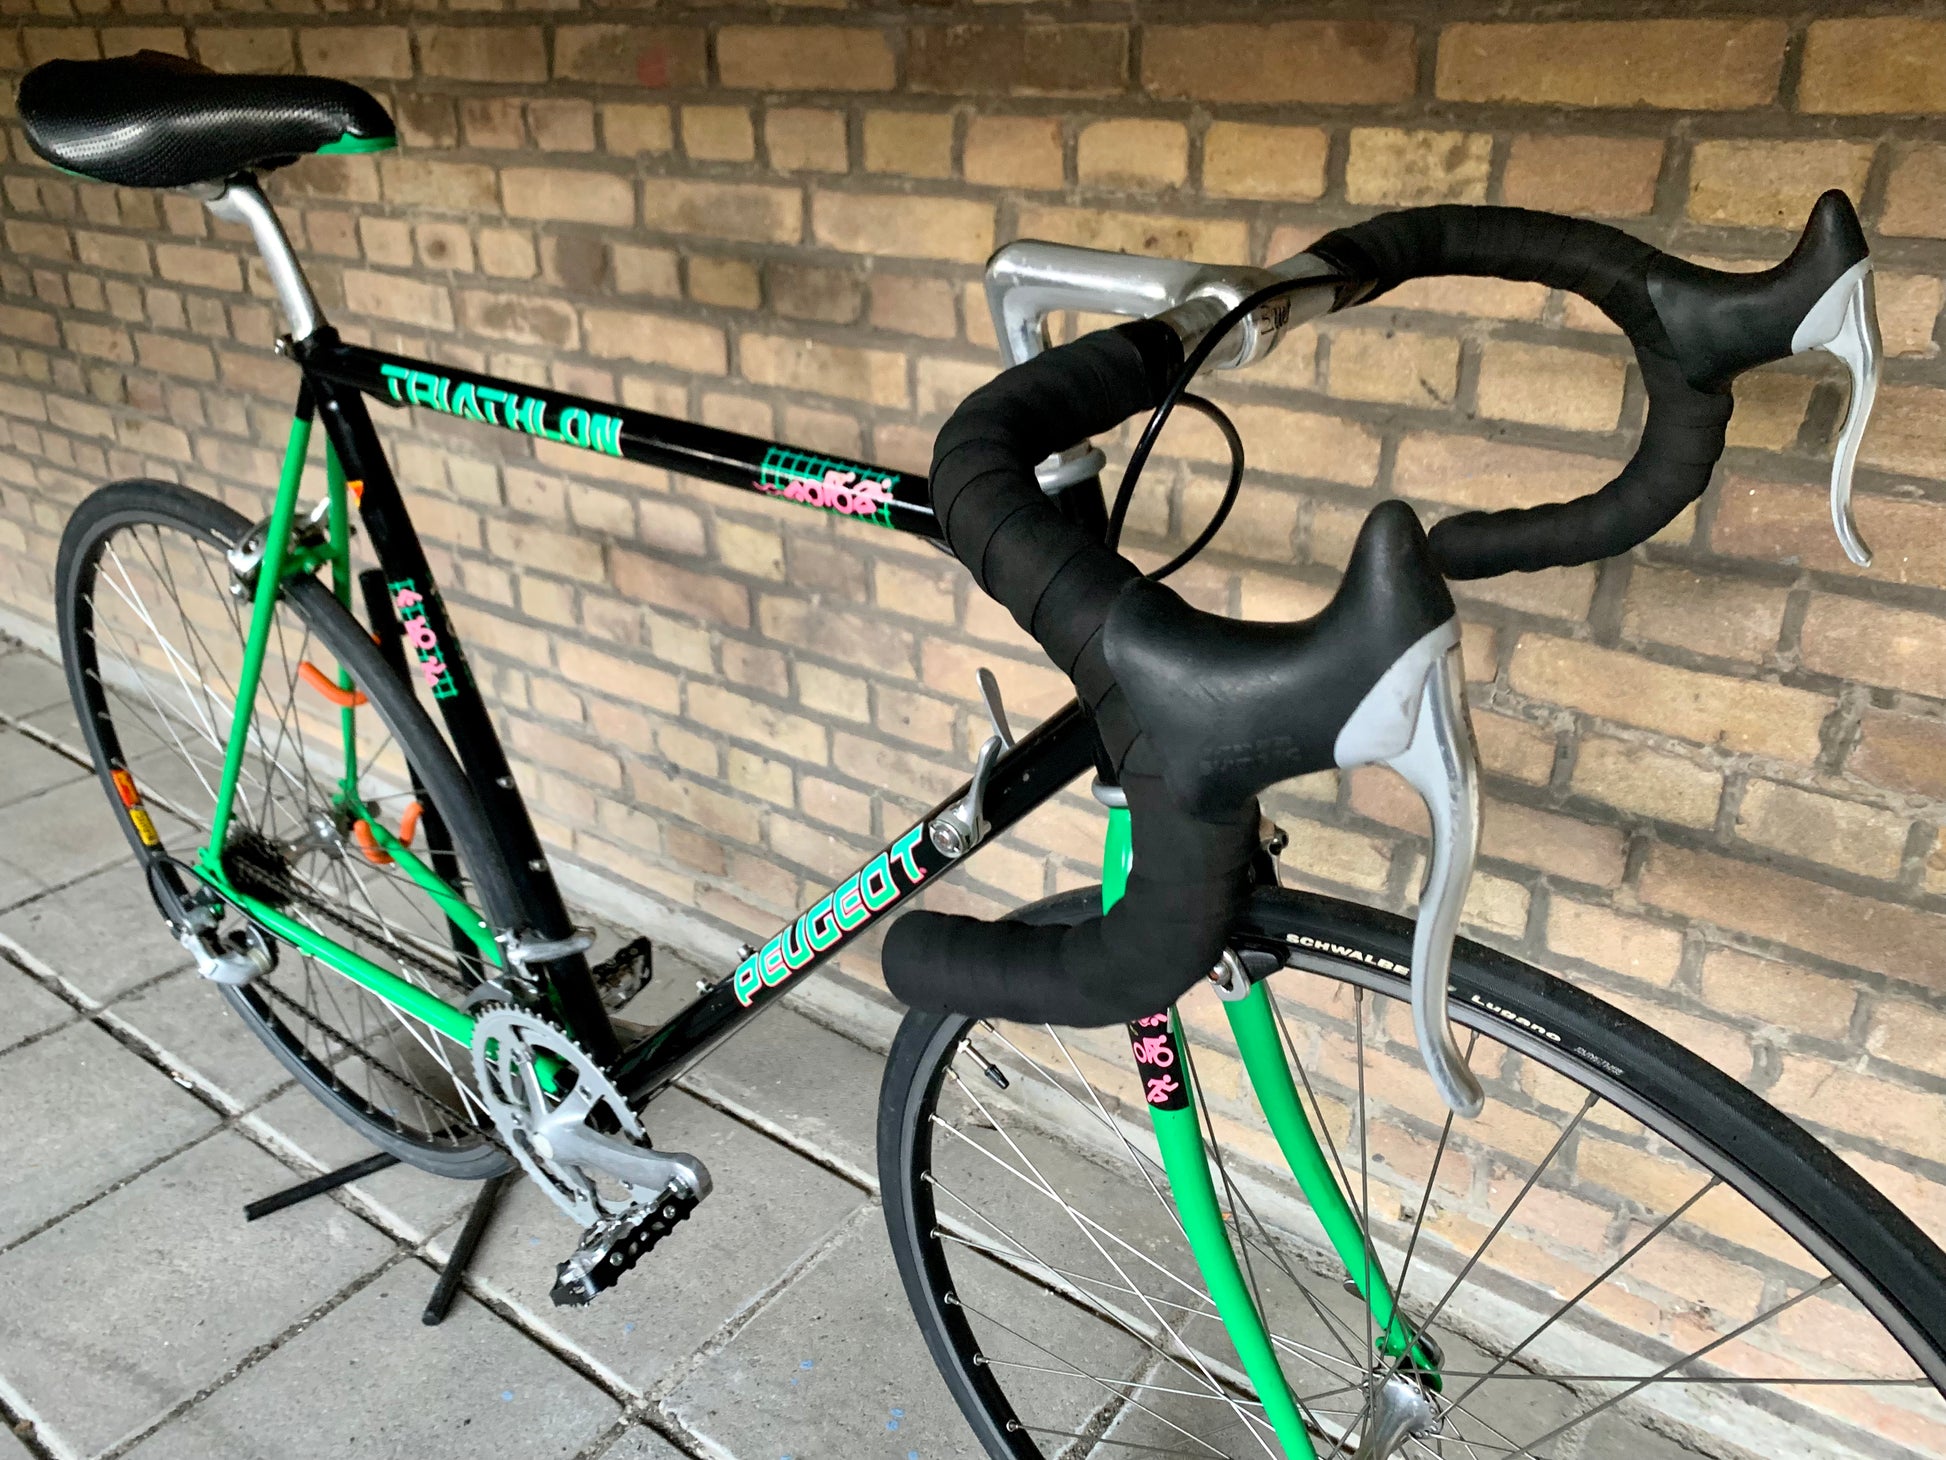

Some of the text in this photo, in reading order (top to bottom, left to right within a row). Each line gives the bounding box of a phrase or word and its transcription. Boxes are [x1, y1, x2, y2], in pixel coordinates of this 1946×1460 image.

[380, 364, 624, 457] TRIATHLON
[733, 822, 925, 1008] PEUGEOT
[1286, 933, 1410, 976] SCHWALBE
[1471, 994, 1562, 1042] Lugano
